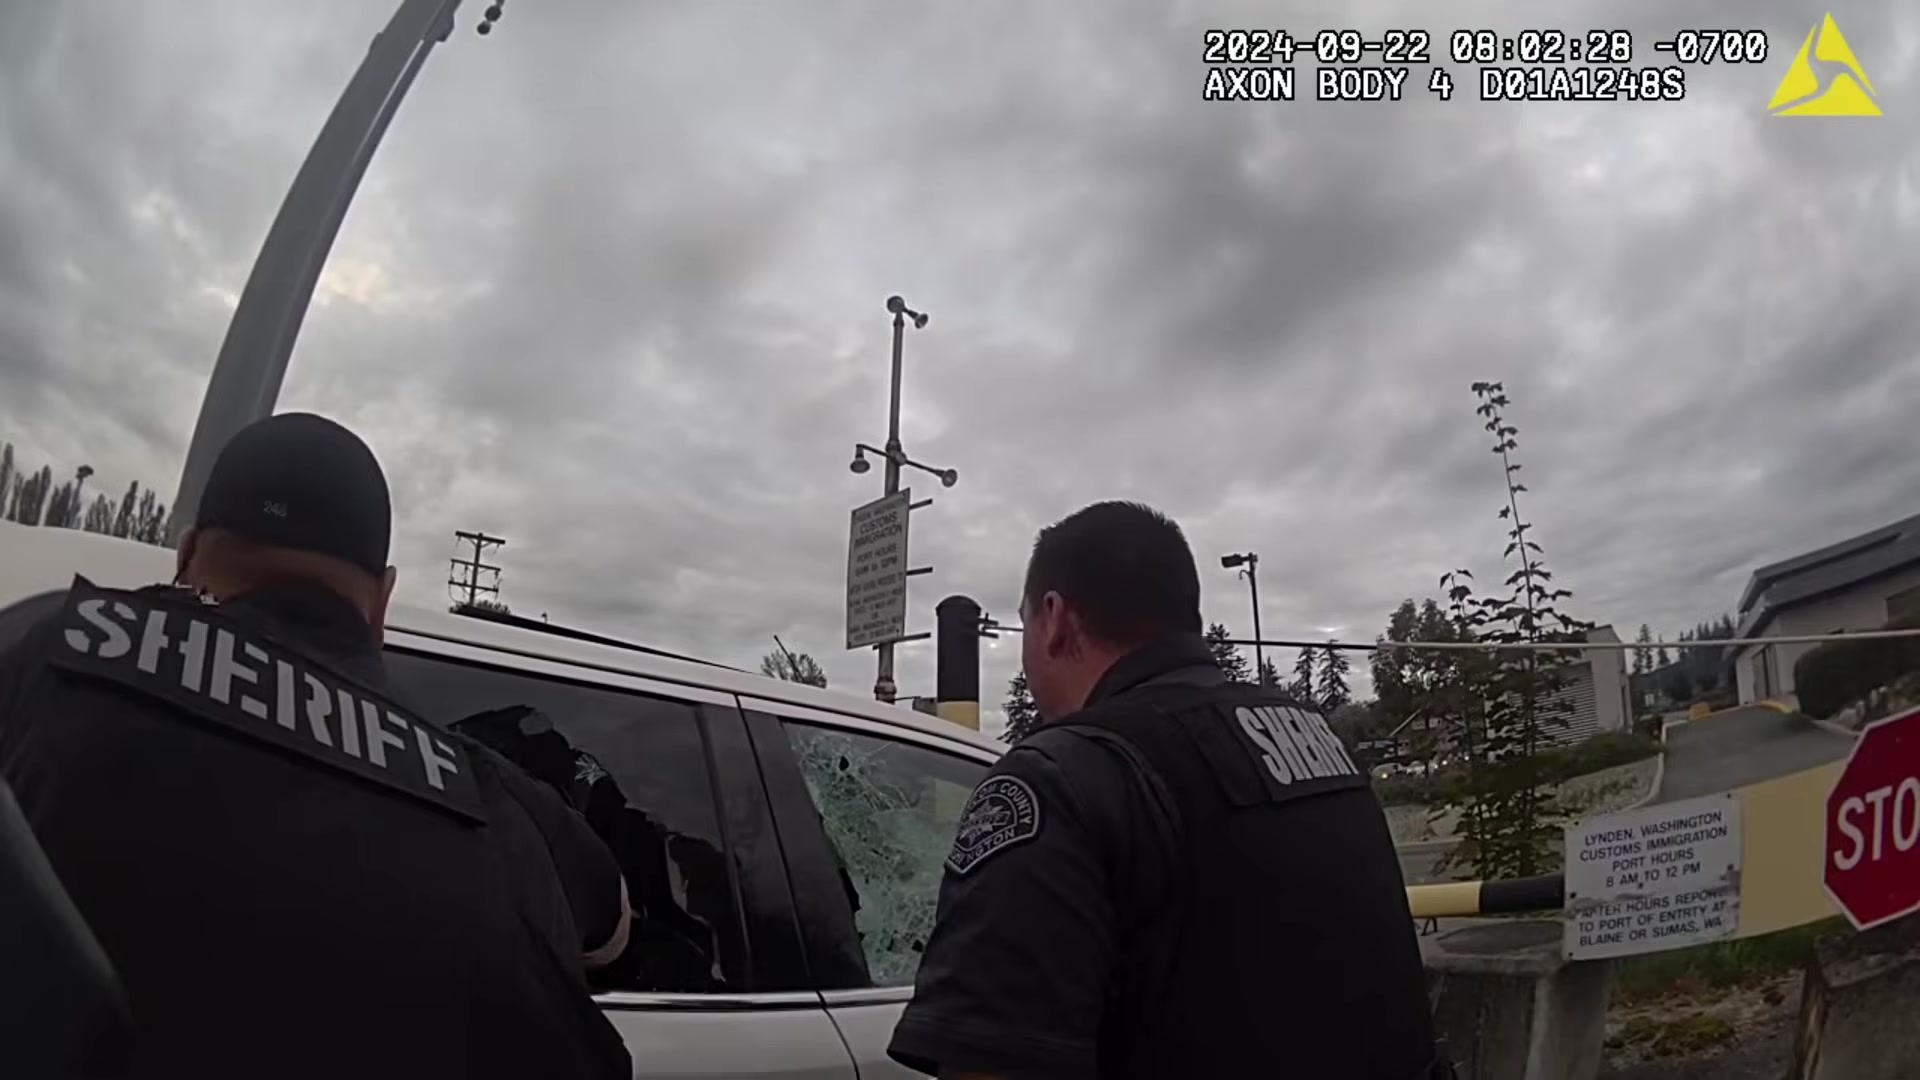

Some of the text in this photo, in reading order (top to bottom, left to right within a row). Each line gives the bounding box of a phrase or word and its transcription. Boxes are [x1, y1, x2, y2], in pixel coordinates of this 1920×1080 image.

[855, 524, 902, 548] IMMIGRATION
[860, 512, 898, 535] CUSTOMS
[64, 599, 458, 791] SHERIFF
[1000, 782, 1032, 825] COUNTY
[1640, 811, 1722, 837] WASHINGTON
[1580, 825, 1727, 862] CUSTOMS IMMIGRATION
[1613, 848, 1694, 872] PORT HOURS
[1606, 862, 1700, 887] 8 AM TO 12 PM
[1579, 919, 1594, 932] TO
[1600, 916, 1632, 930] PORT
[1637, 913, 1654, 925] OF
[1712, 901, 1726, 912] AT
[1626, 896, 1669, 912] HOURS
[1579, 916, 1722, 946] BLAINE OR SUMAS, WA
